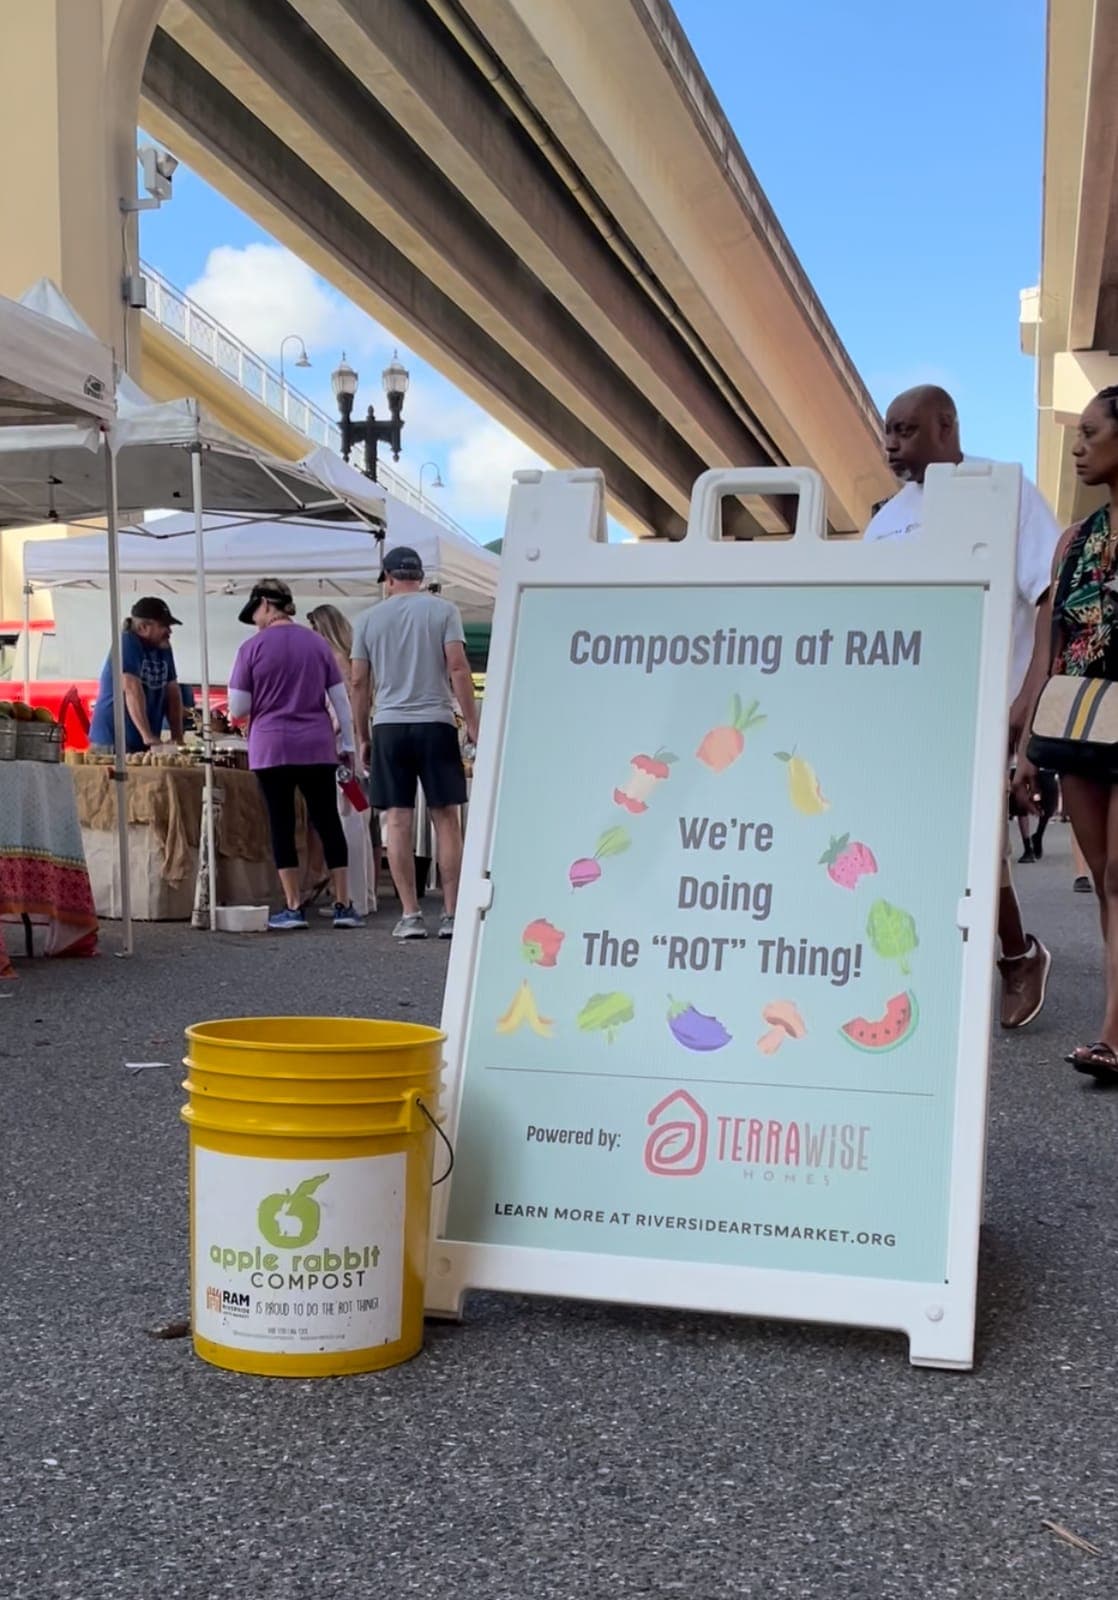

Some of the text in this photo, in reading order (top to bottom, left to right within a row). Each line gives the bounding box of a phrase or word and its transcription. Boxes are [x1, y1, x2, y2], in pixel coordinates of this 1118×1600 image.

[569, 627, 922, 674] Composting at RAM
[679, 816, 774, 852] We’re
[677, 876, 773, 921] Doing
[582, 930, 864, 986] The “ROT” Thing!
[526, 1124, 622, 1151] Powered by:
[743, 1169, 831, 1187] HOMES
[494, 1202, 897, 1248] LEARN MORE AT RIVERSIDEARTSMARKET.ORG
[209, 1244, 380, 1273] apple rabbit
[250, 1270, 365, 1290] COMPOST
[222, 1290, 250, 1307] RAM
[256, 1301, 263, 1314] IS
[265, 1302, 290, 1316] PROUD
[293, 1303, 304, 1316] TO
[306, 1303, 319, 1316] DO
[321, 1302, 335, 1315] THE
